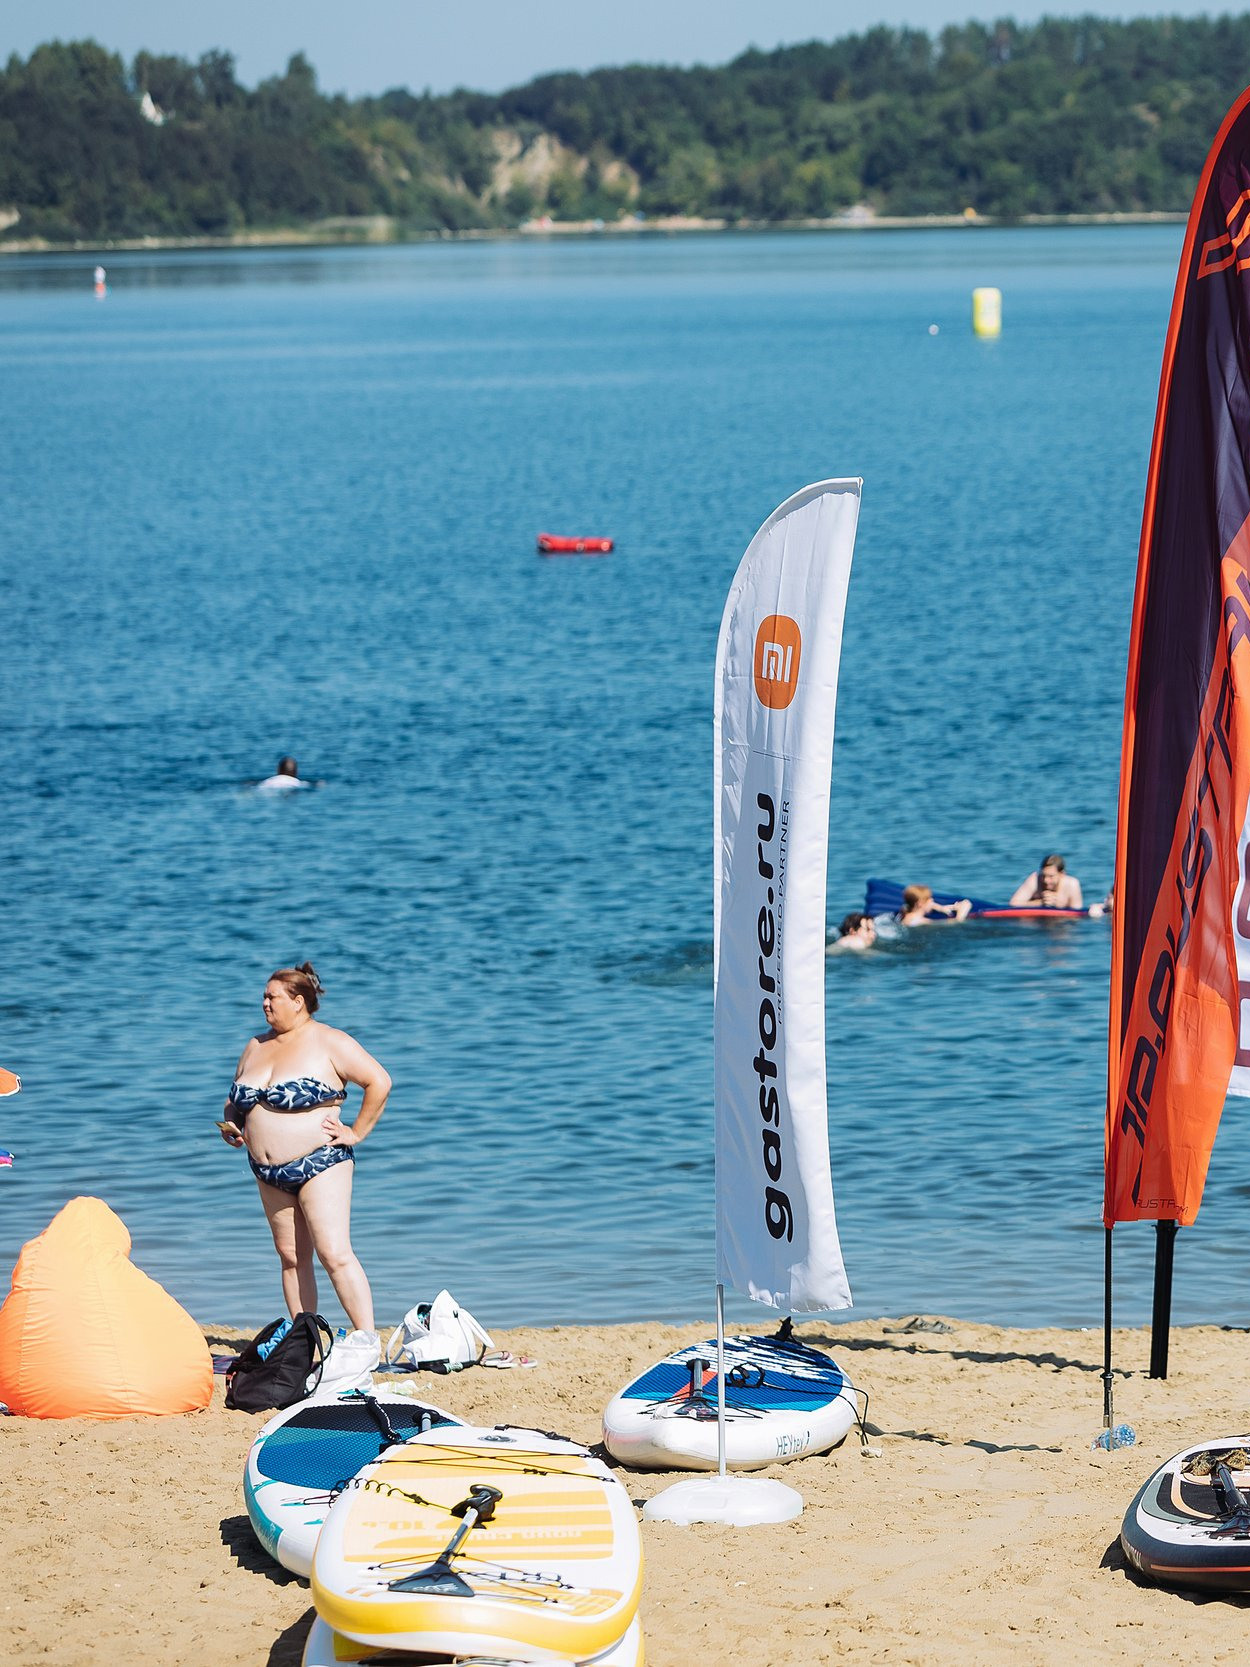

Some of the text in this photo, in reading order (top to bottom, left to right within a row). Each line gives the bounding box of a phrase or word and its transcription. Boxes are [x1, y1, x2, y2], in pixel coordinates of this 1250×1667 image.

[757, 792, 794, 1243] gastore.ru
[776, 800, 790, 1025] PREFERRED PARTNER
